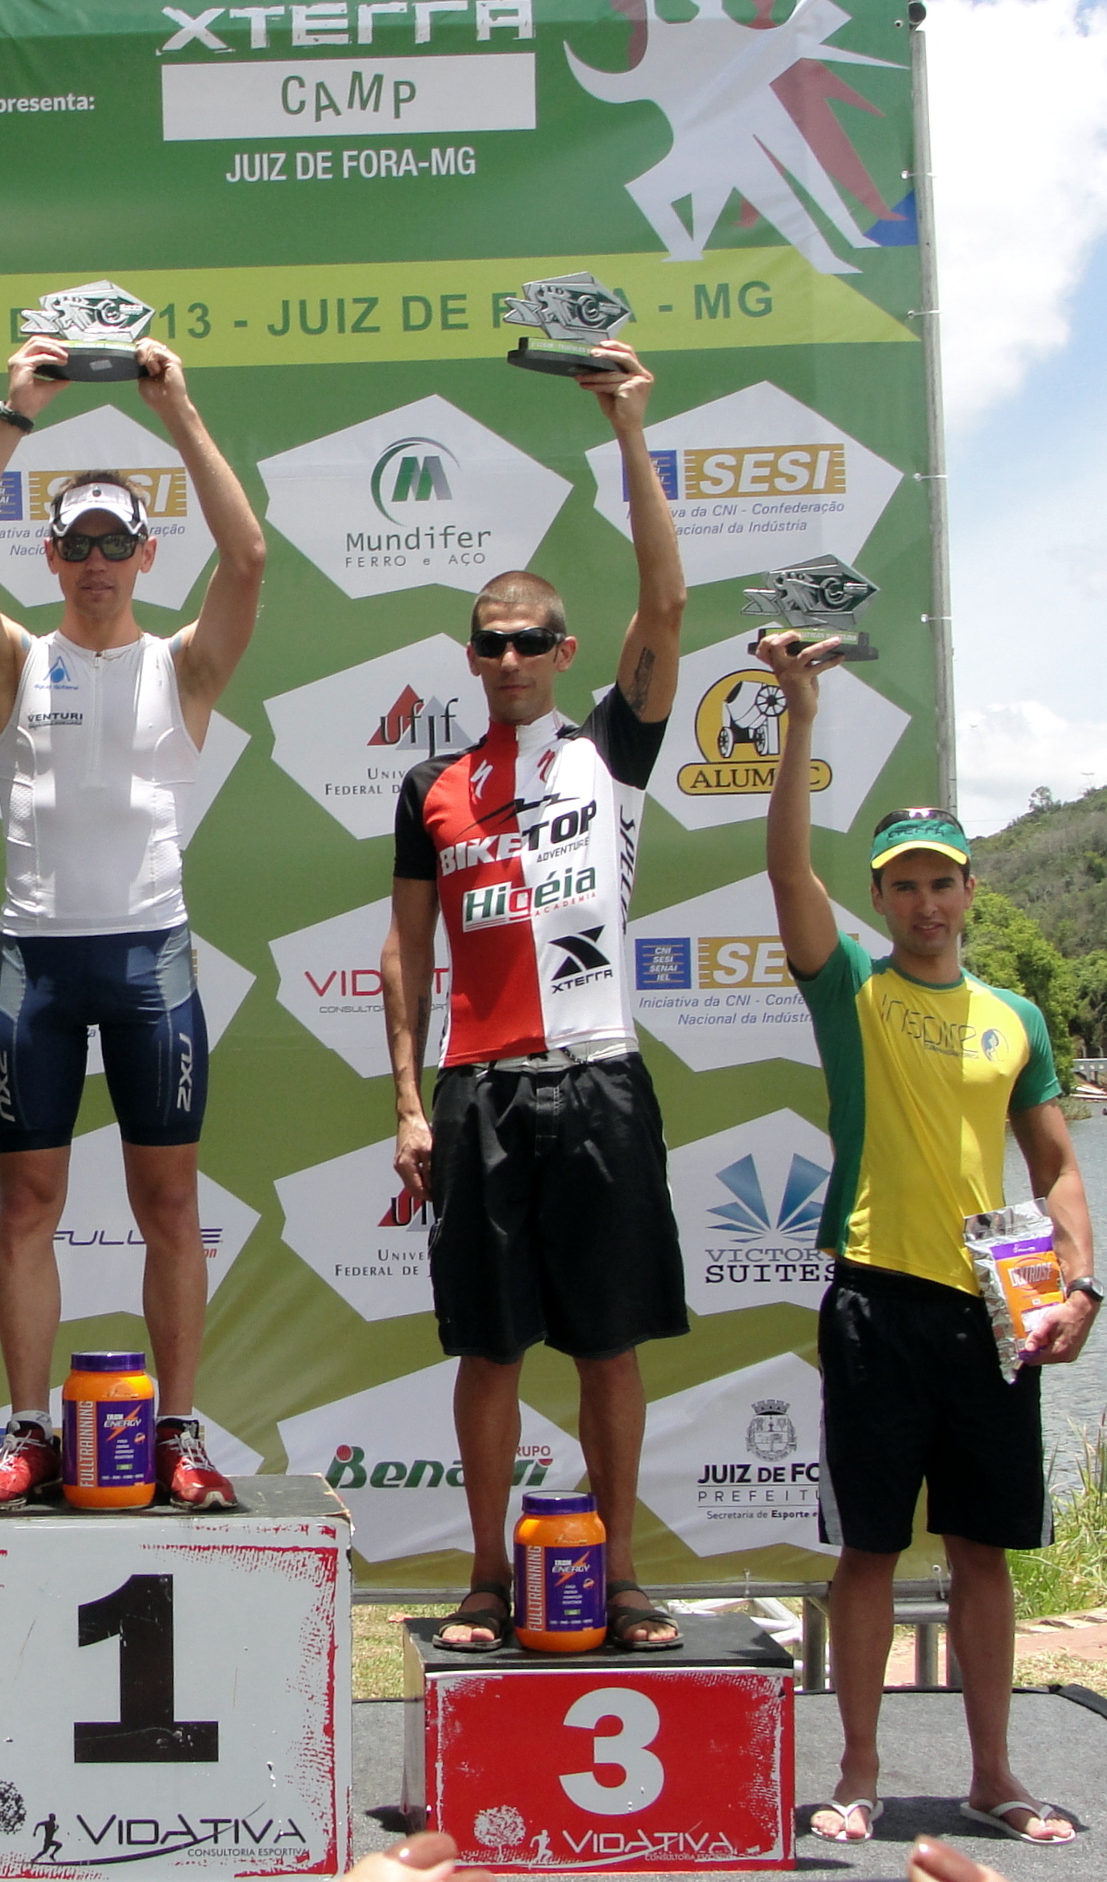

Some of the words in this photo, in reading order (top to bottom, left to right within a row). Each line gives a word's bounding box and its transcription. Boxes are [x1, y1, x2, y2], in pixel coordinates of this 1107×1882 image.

[281, 71, 417, 122] CAMP
[226, 153, 287, 183] JUIZ
[296, 151, 333, 180] DE
[342, 147, 476, 179] FORA-MG
[267, 296, 381, 336] JUIZ
[403, 293, 469, 332] DE
[695, 281, 774, 320] MG
[699, 451, 830, 495] SESI
[690, 505, 707, 518] da
[712, 504, 738, 517] CNI
[752, 501, 845, 517] Confederação
[727, 521, 744, 534] da
[748, 519, 808, 534] Indústria
[346, 525, 492, 552] Mundifer
[10, 544, 47, 557] Nacio
[345, 555, 407, 568] FERRO
[423, 557, 431, 566] e
[448, 553, 486, 567] AÇO
[27, 712, 83, 723] VENTURI
[325, 783, 383, 796] FEDERAL
[536, 837, 590, 863] ADVENTURE
[466, 867, 596, 922] Higéia
[534, 892, 597, 917] ACADEMIA
[649, 965, 678, 973] SENAI
[639, 996, 699, 1008] Iniciativa
[704, 996, 720, 1007] da
[725, 995, 751, 1006] CNI
[319, 1005, 384, 1014] CONSULTO
[678, 1014, 736, 1025] Nacional
[741, 1013, 757, 1024] da
[177, 1033, 193, 1112] 2XU
[705, 1248, 835, 1262] VICTOR
[334, 1264, 393, 1276] FEDERAL
[402, 1265, 419, 1275] DE
[705, 1264, 835, 1283] SUITES
[103, 1418, 142, 1428] ENERGY
[515, 1445, 551, 1457] RUPO
[697, 1464, 751, 1484] JUIZ
[757, 1467, 786, 1483] DE
[791, 1463, 819, 1482] FO
[698, 1490, 819, 1502] PREFEIT
[706, 1511, 754, 1519] Secretaria
[757, 1510, 768, 1519] de
[771, 1510, 809, 1520] Esporte
[551, 1564, 591, 1573] ENERGY
[74, 1574, 219, 1763] 1
[559, 1687, 665, 1815] 3
[77, 1814, 306, 1846] VIDATIVA
[562, 1829, 734, 1854] VIDATIVA
[187, 1848, 255, 1857] CONSULTORIA
[258, 1848, 309, 1857] ESPORTIVA
